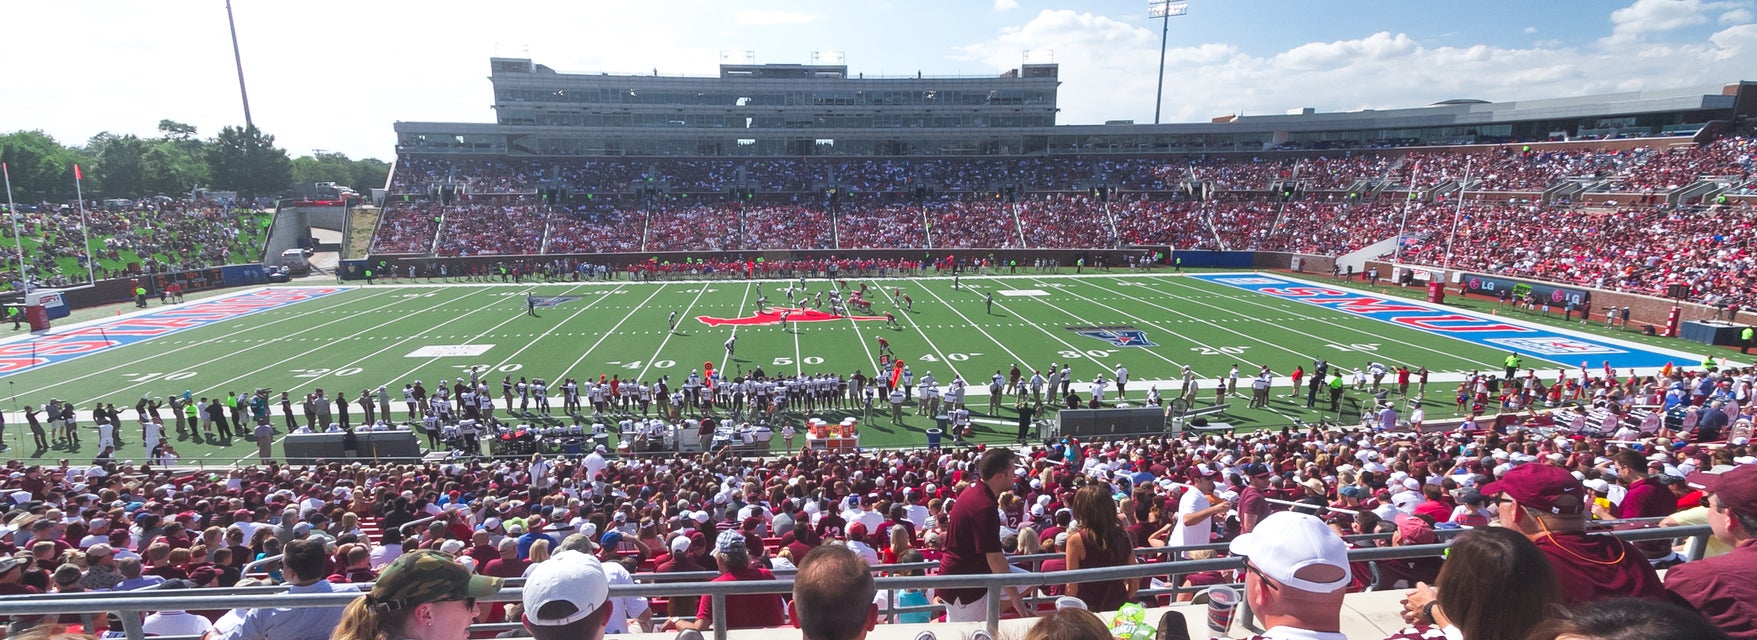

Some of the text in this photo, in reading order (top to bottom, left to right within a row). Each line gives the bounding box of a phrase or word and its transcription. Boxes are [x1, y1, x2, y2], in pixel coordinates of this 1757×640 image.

[1481, 281, 1495, 291] LG
[1257, 286, 1537, 332] SMU
[1057, 349, 1110, 359] 30
[1190, 346, 1246, 356] 20
[772, 356, 825, 366] 50
[919, 352, 969, 362] 40
[621, 360, 676, 370] 40
